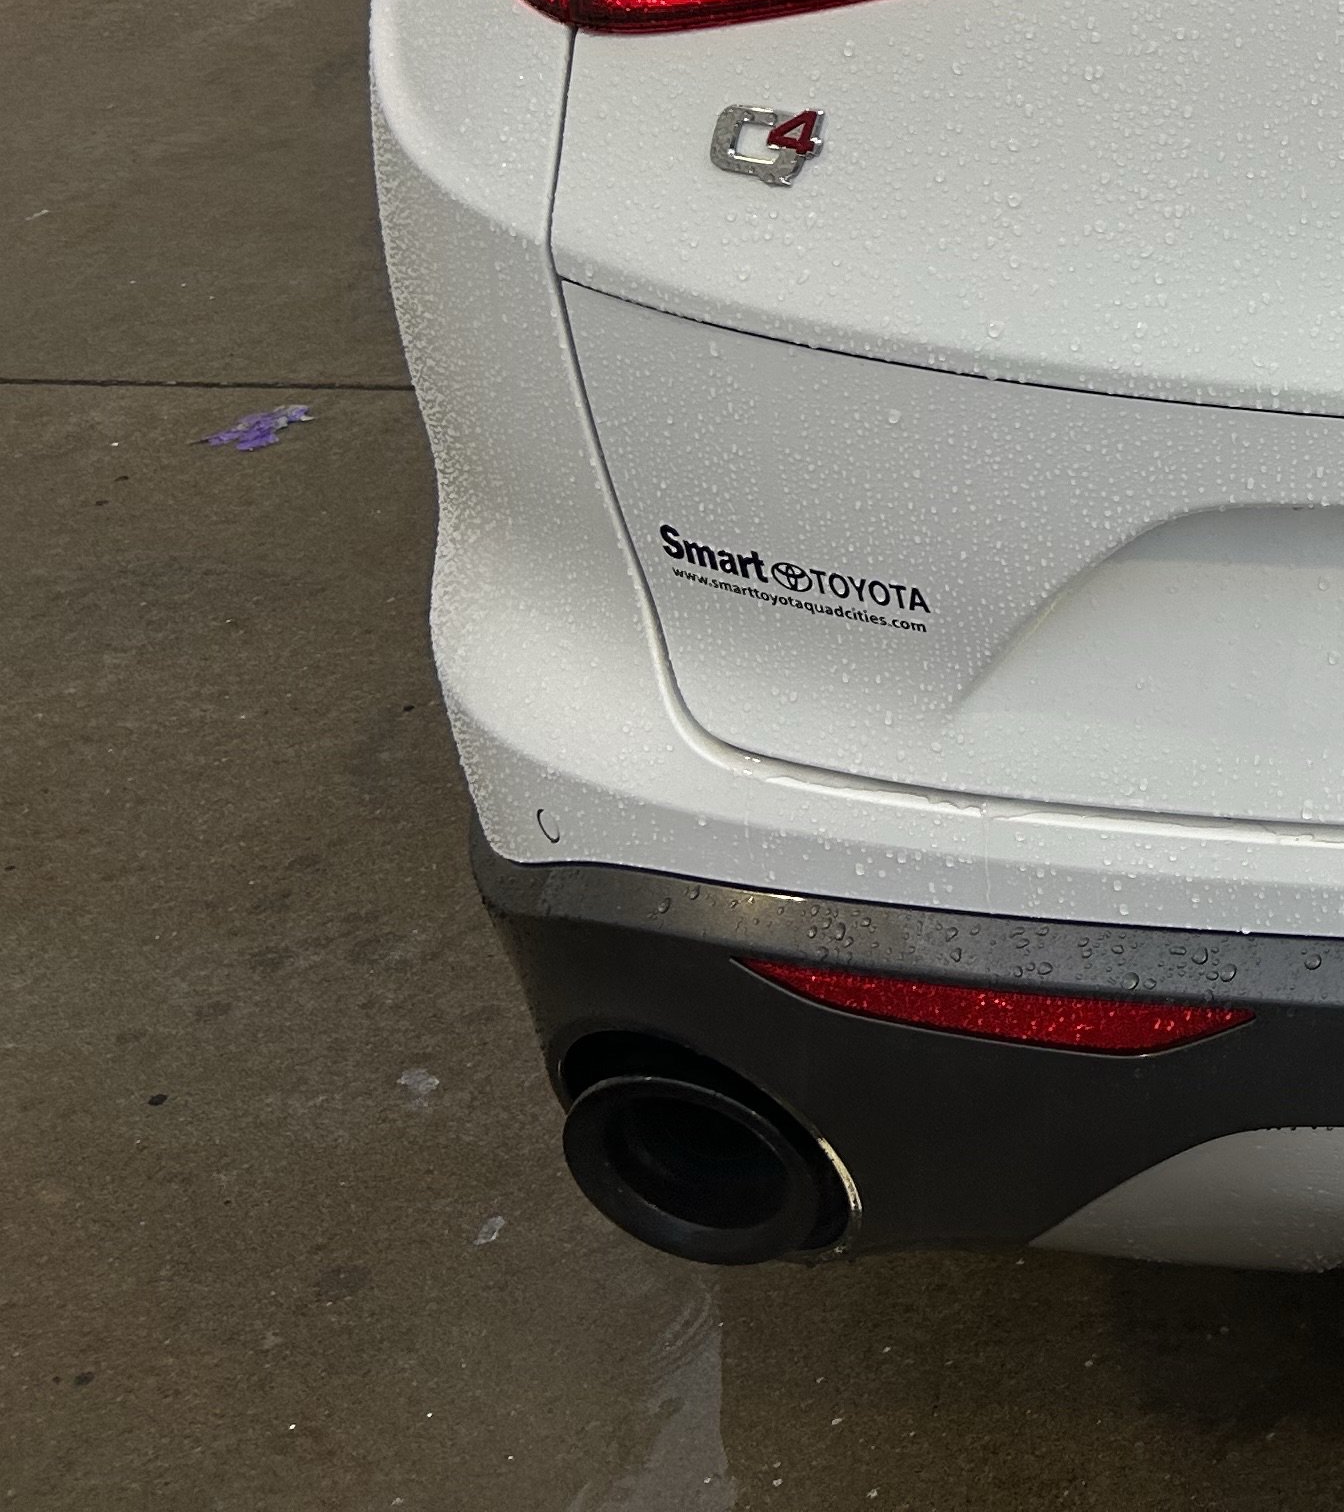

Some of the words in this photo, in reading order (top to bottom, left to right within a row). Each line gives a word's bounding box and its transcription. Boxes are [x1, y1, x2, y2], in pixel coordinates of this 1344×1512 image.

[658, 523, 769, 585] Smart
[809, 568, 932, 615] TOYOTA
[671, 566, 928, 634] www.smarttoyotaquadcities.com
